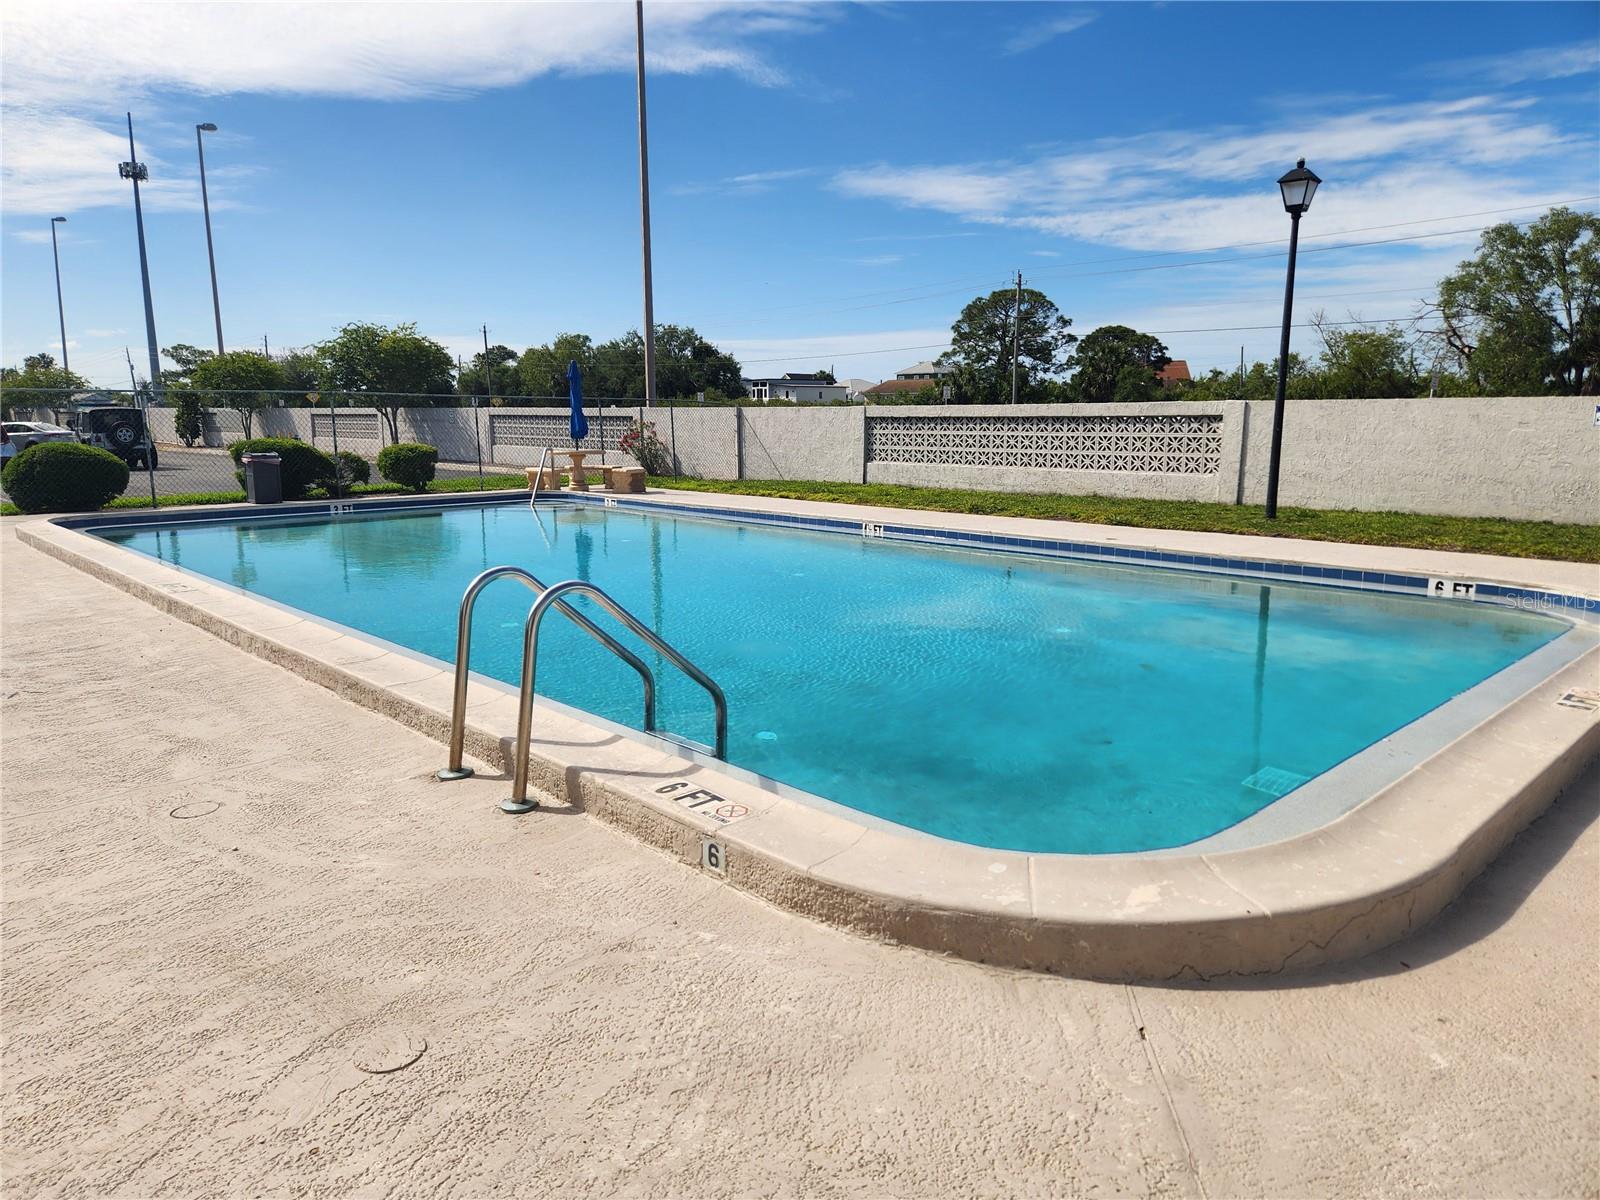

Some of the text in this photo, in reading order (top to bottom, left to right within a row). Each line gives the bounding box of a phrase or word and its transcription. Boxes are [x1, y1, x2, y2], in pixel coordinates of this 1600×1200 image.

[1453, 582, 1474, 595] FT
[655, 782, 726, 809] 6 FT
[708, 842, 719, 868] 6
